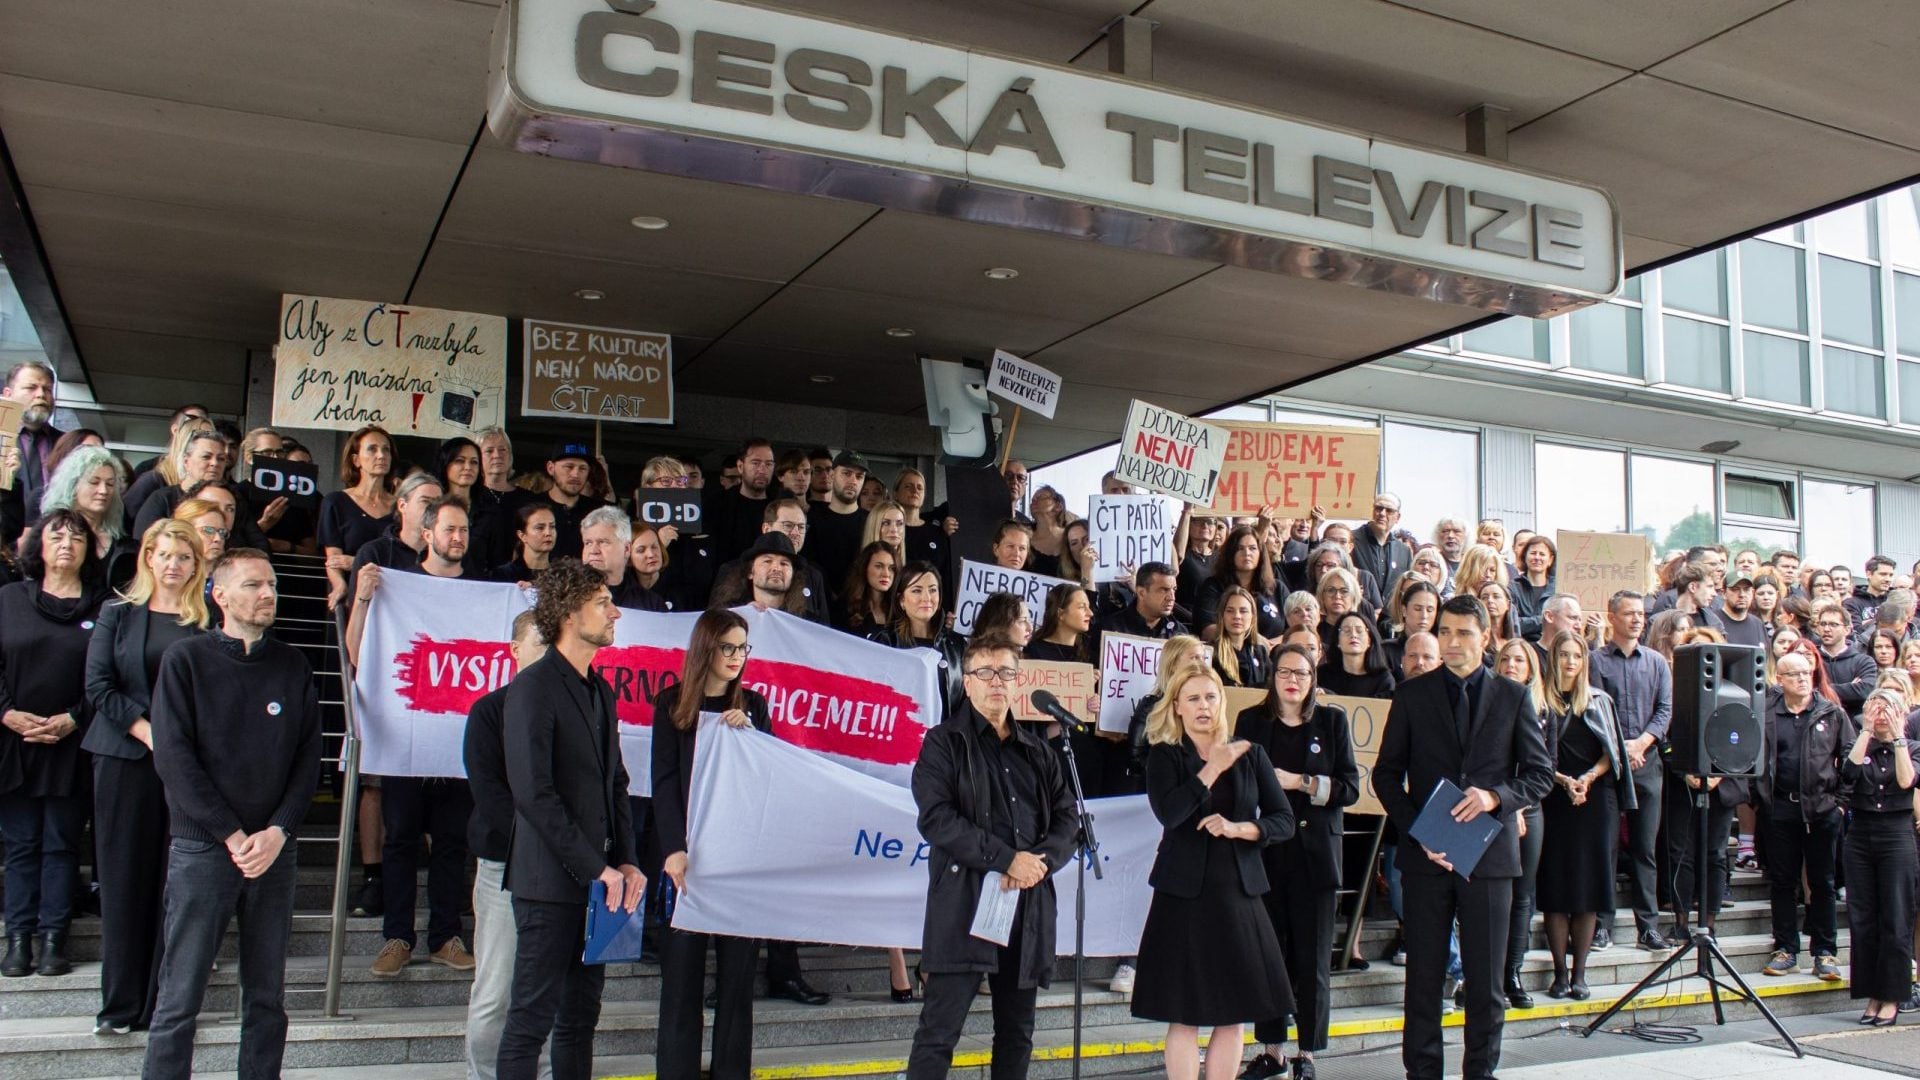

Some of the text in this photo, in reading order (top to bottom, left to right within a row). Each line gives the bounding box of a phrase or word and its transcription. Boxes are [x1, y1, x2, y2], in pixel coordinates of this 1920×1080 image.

[574, 0, 1585, 270] ČESKÁ TELEVIZE
[284, 299, 486, 366] Aby z ČT nezbyla
[532, 327, 668, 361] BEZ KULTURY
[291, 362, 439, 401] jen prázdná
[535, 355, 662, 384] NENÍ NÁROD
[997, 357, 1057, 394] TATO TELEVIZE
[551, 379, 646, 417] ČT ART
[998, 375, 1049, 406] NEVZKVÉTÁ
[1140, 407, 1214, 450] DŮVĚRA
[1134, 430, 1199, 471] NENÍ
[1224, 430, 1345, 468] EBUDEME
[1096, 498, 1165, 532] ČT PATŘÍ
[1574, 535, 1615, 561] ZA
[1563, 559, 1639, 581] PESTRÉ
[1014, 668, 1086, 689] BUDEME
[1107, 679, 1130, 699] SE
[853, 828, 905, 859] Ne
